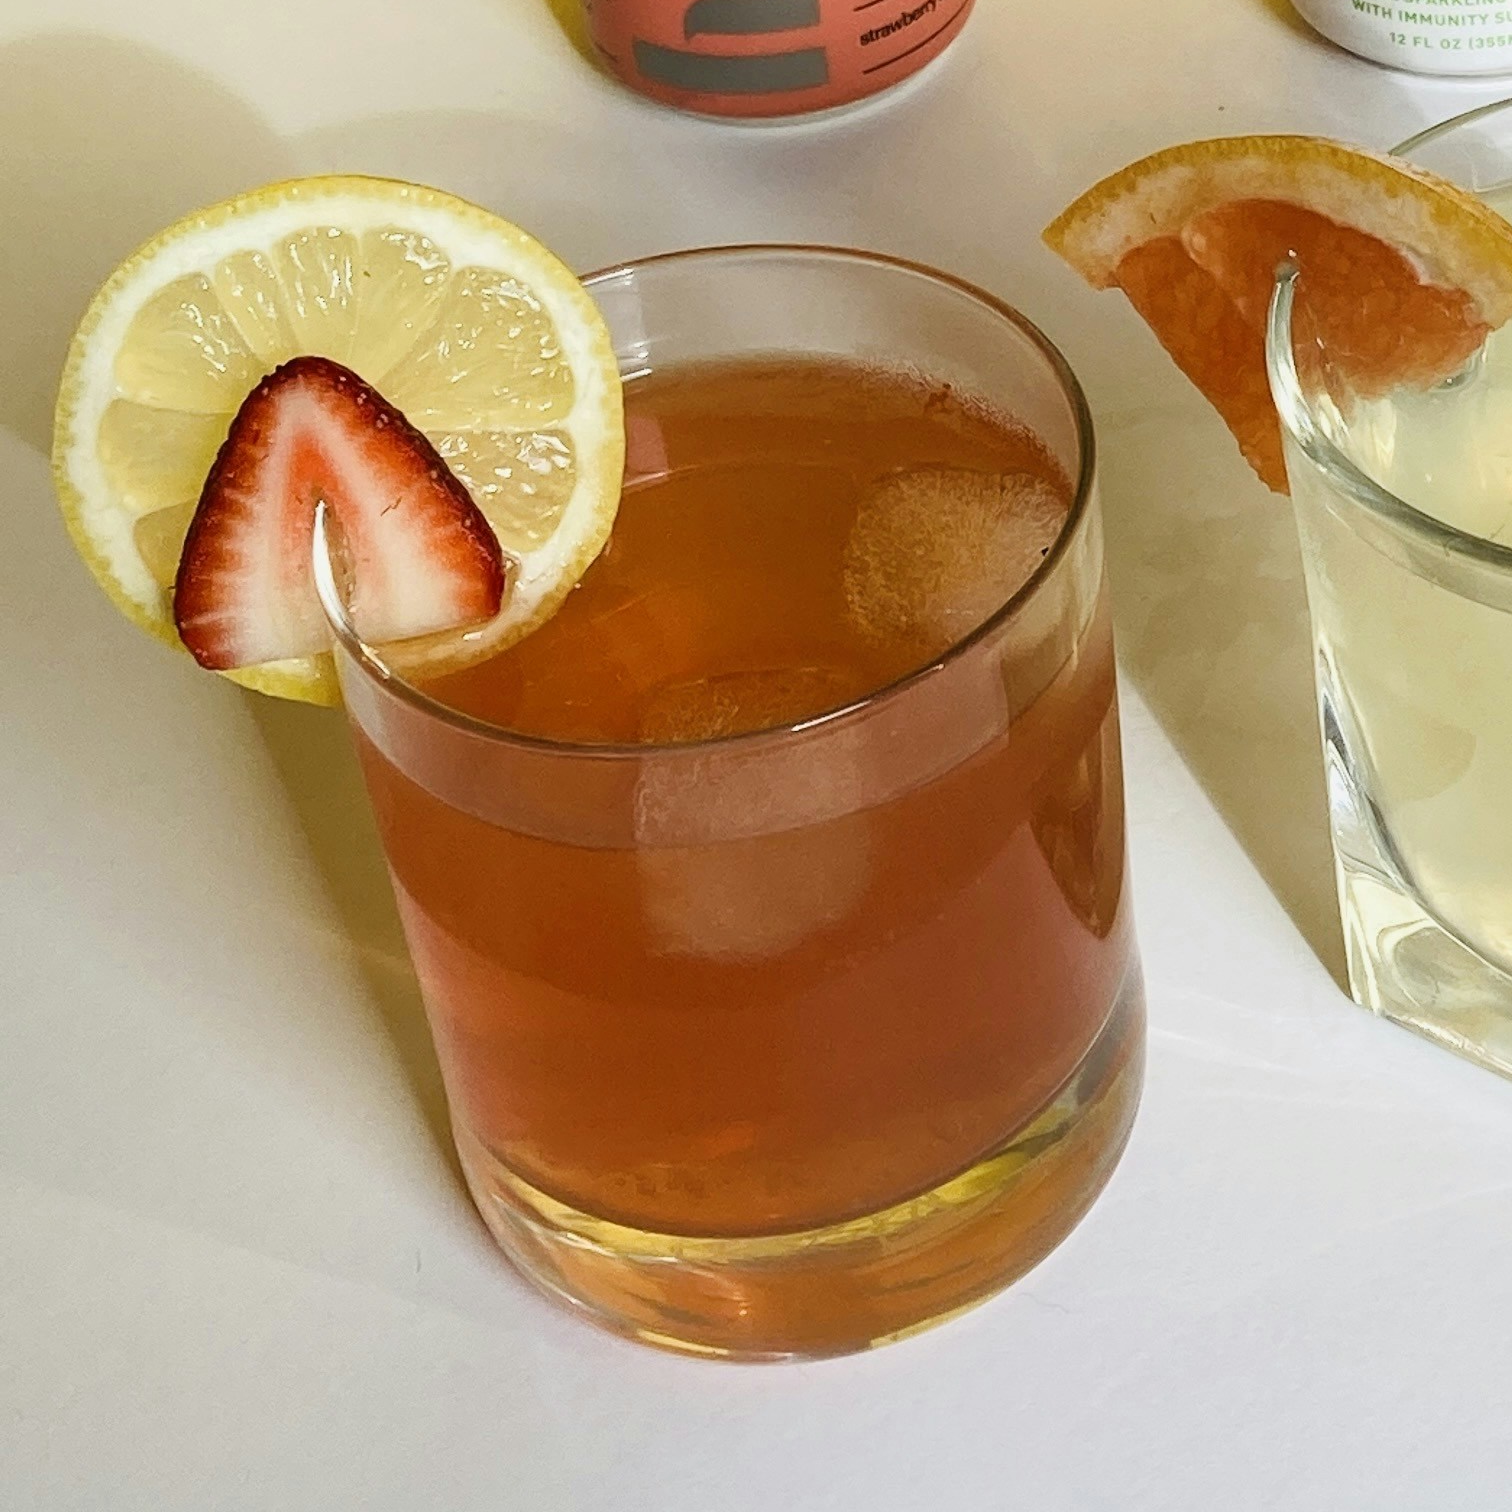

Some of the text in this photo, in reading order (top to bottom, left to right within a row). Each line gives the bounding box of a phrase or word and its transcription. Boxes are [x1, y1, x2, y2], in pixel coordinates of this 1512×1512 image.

[1399, 10, 1489, 26] IMMUNITY
[1389, 31, 1406, 45] 12
[1413, 35, 1433, 48] FL
[1440, 39, 1461, 50] OZ
